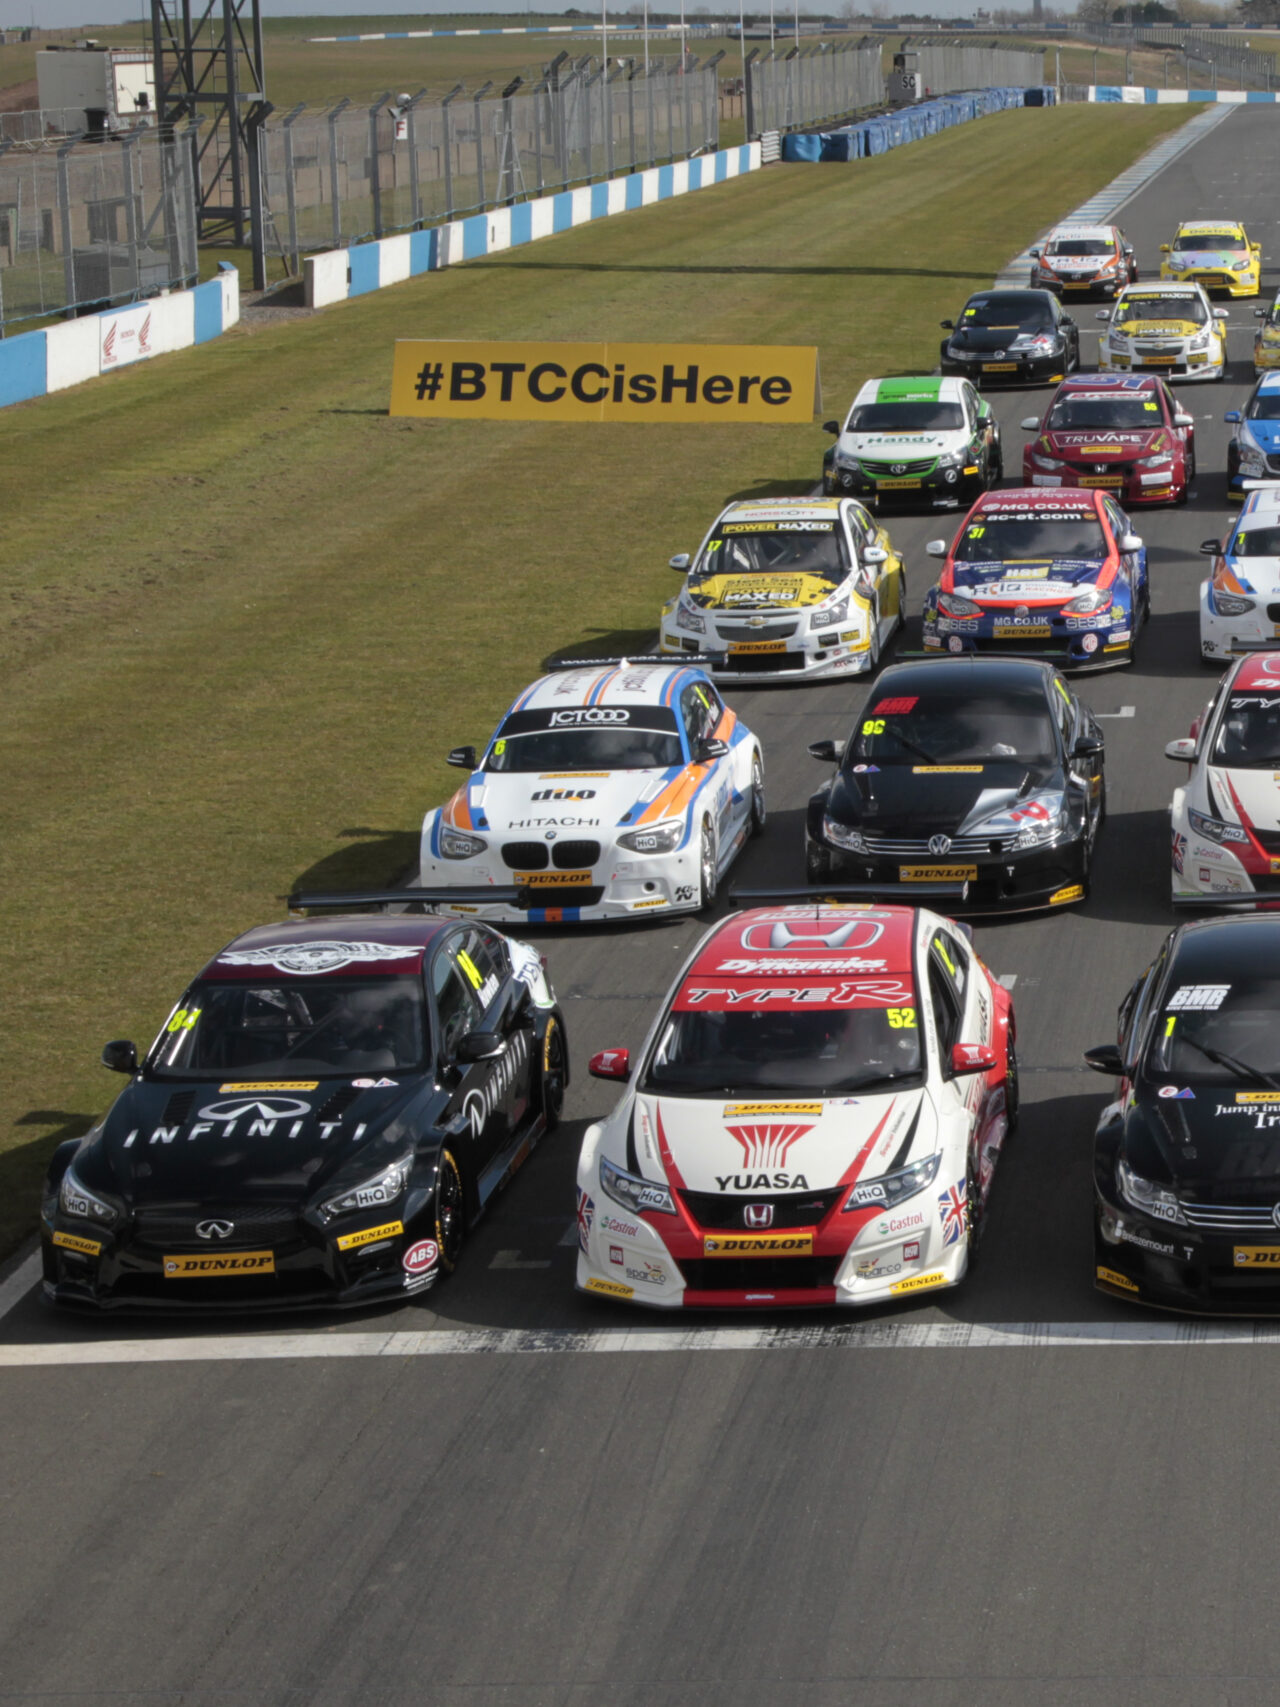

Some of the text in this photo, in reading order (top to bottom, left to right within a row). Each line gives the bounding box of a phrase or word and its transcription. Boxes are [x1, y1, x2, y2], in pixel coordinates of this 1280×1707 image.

[414, 362, 793, 405] #BTCCisHere
[867, 436, 937, 444] Handy
[1064, 432, 1143, 443] TRUVAPE
[1000, 503, 1091, 511] MG.CO.UK
[987, 512, 1082, 521] ac-et.com
[725, 521, 831, 532] POWER MAXED
[968, 527, 986, 539] 31
[1237, 533, 1246, 544] 7
[707, 540, 723, 552] 17
[950, 619, 979, 632] SES
[993, 616, 1049, 626] MG.CO.UK
[1066, 617, 1095, 629] SES
[1003, 628, 1050, 636] DUNLOP
[738, 643, 785, 651] DUNLOP
[548, 708, 631, 726] JCT600
[494, 739, 506, 755] 6
[531, 787, 597, 801] duo
[508, 817, 600, 829] HITACHI
[1223, 828, 1242, 838] HiQ
[456, 842, 471, 852] HiQ
[636, 837, 656, 847] HiQ
[1020, 835, 1038, 847] HiQ
[1200, 849, 1224, 860] Castrol
[528, 874, 592, 884] DUNLOP
[913, 868, 978, 878] DUNLOP
[451, 905, 478, 913] DUNLOP
[634, 899, 667, 908] DUNLOP
[716, 957, 887, 974] Dynamics
[1168, 990, 1228, 1006] BMR
[167, 1008, 203, 1033] 84
[887, 1007, 917, 1028] 52
[1164, 1016, 1176, 1037] 1
[739, 1102, 821, 1112] DUNLOP
[1215, 1103, 1259, 1116] Jump
[123, 1119, 367, 1147] INFINITI
[715, 1173, 809, 1191] YUASA
[358, 1189, 385, 1205] HiQ
[638, 1189, 665, 1205] HiQ
[857, 1186, 884, 1200] HiQ
[67, 1200, 87, 1214] HiQ
[1153, 1203, 1177, 1218] HiQ
[608, 1218, 640, 1237] Castrol
[889, 1212, 924, 1232] Castrol
[351, 1224, 400, 1244] DUNLOP
[62, 1237, 99, 1251] DUNLOP
[722, 1239, 812, 1251] DUNLOP
[408, 1244, 434, 1265] ABS
[182, 1256, 272, 1272] DUNLOP
[901, 1274, 945, 1290] DUNLOP
[593, 1282, 633, 1296] DUNLOP
